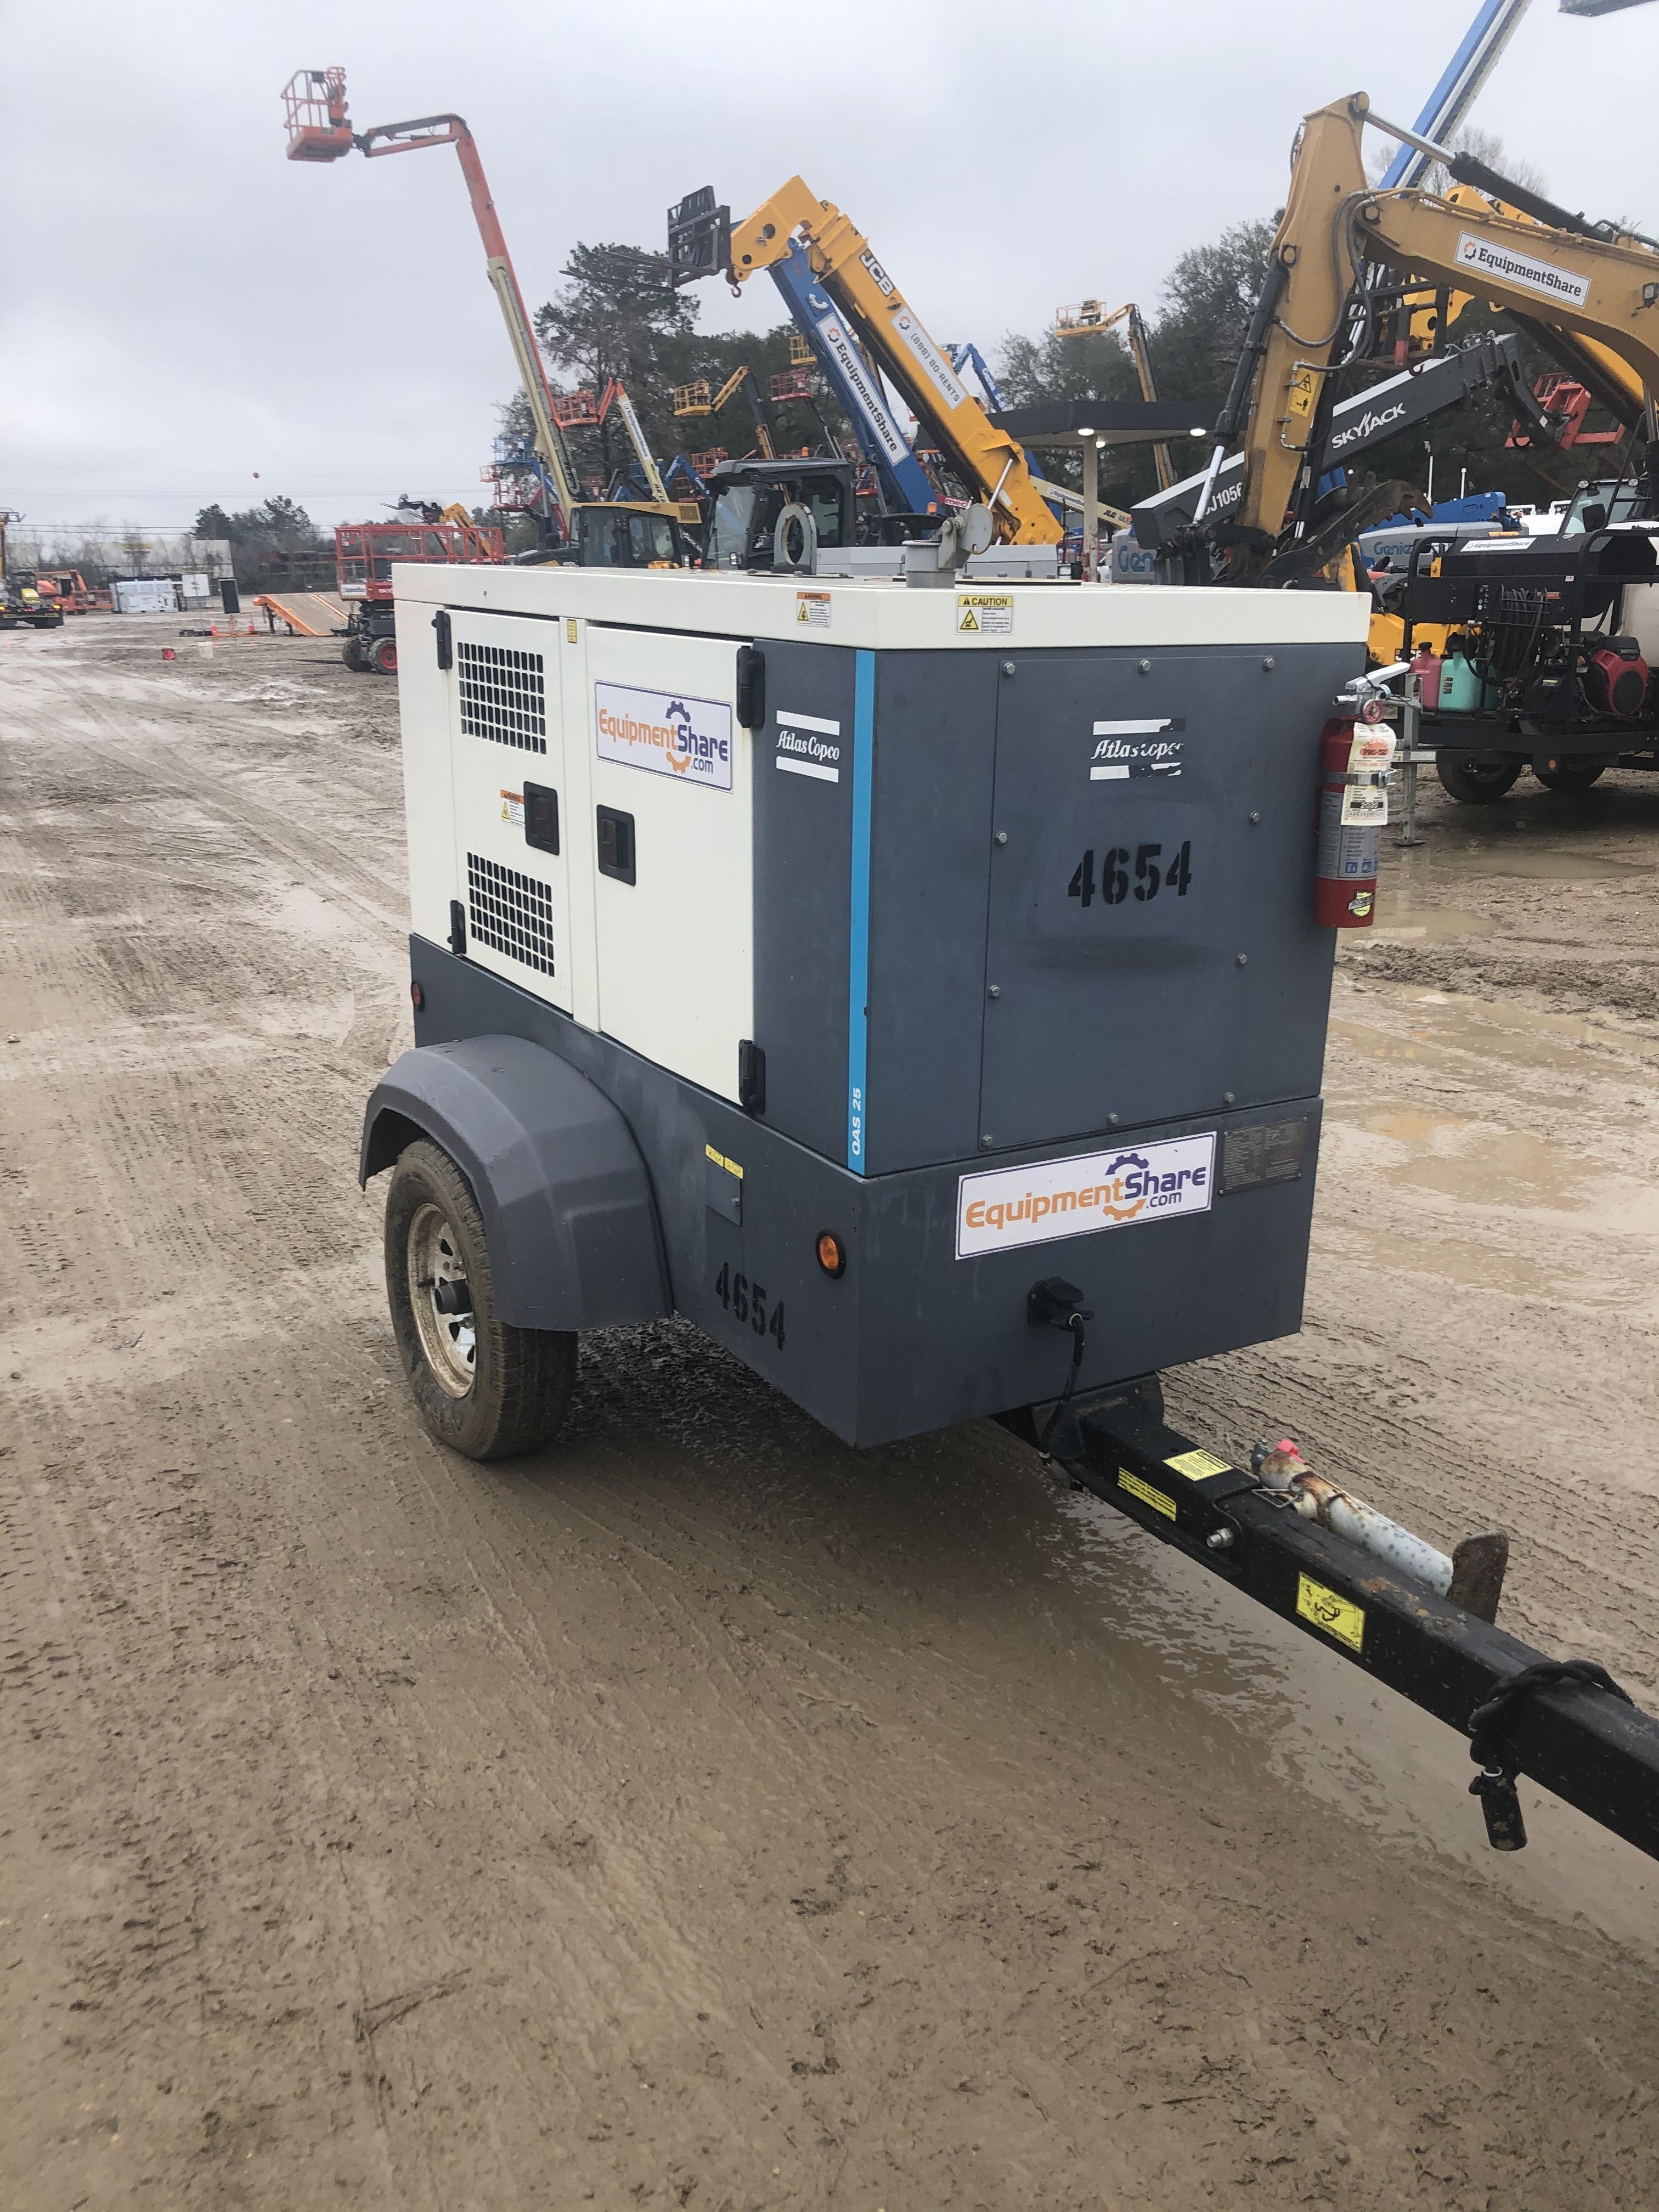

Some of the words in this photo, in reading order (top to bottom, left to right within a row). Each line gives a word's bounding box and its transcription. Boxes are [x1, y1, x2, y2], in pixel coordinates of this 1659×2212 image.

[861, 254, 895, 295] JCB
[1478, 247, 1582, 297] EquipmentShare
[910, 332, 931, 359] (888)
[929, 359, 960, 402] 80-RENTS
[836, 342, 897, 452] EquipmentShare
[1331, 402, 1407, 449] SKYJACK
[1374, 541, 1413, 556] Genie
[972, 597, 1008, 606] CAUTION
[599, 708, 728, 761] EquipmentShare
[776, 730, 808, 753] Atlas
[808, 736, 840, 761] Copco
[1091, 740, 1139, 759] Atlas
[691, 758, 714, 774] .com
[1068, 840, 1192, 908] 4654
[853, 1087, 861, 1111] 25
[851, 1115, 861, 1155] QAS
[966, 1166, 1206, 1229] EquipmentShare
[1146, 1192, 1182, 1209] .com
[715, 1262, 786, 1351] 4654
